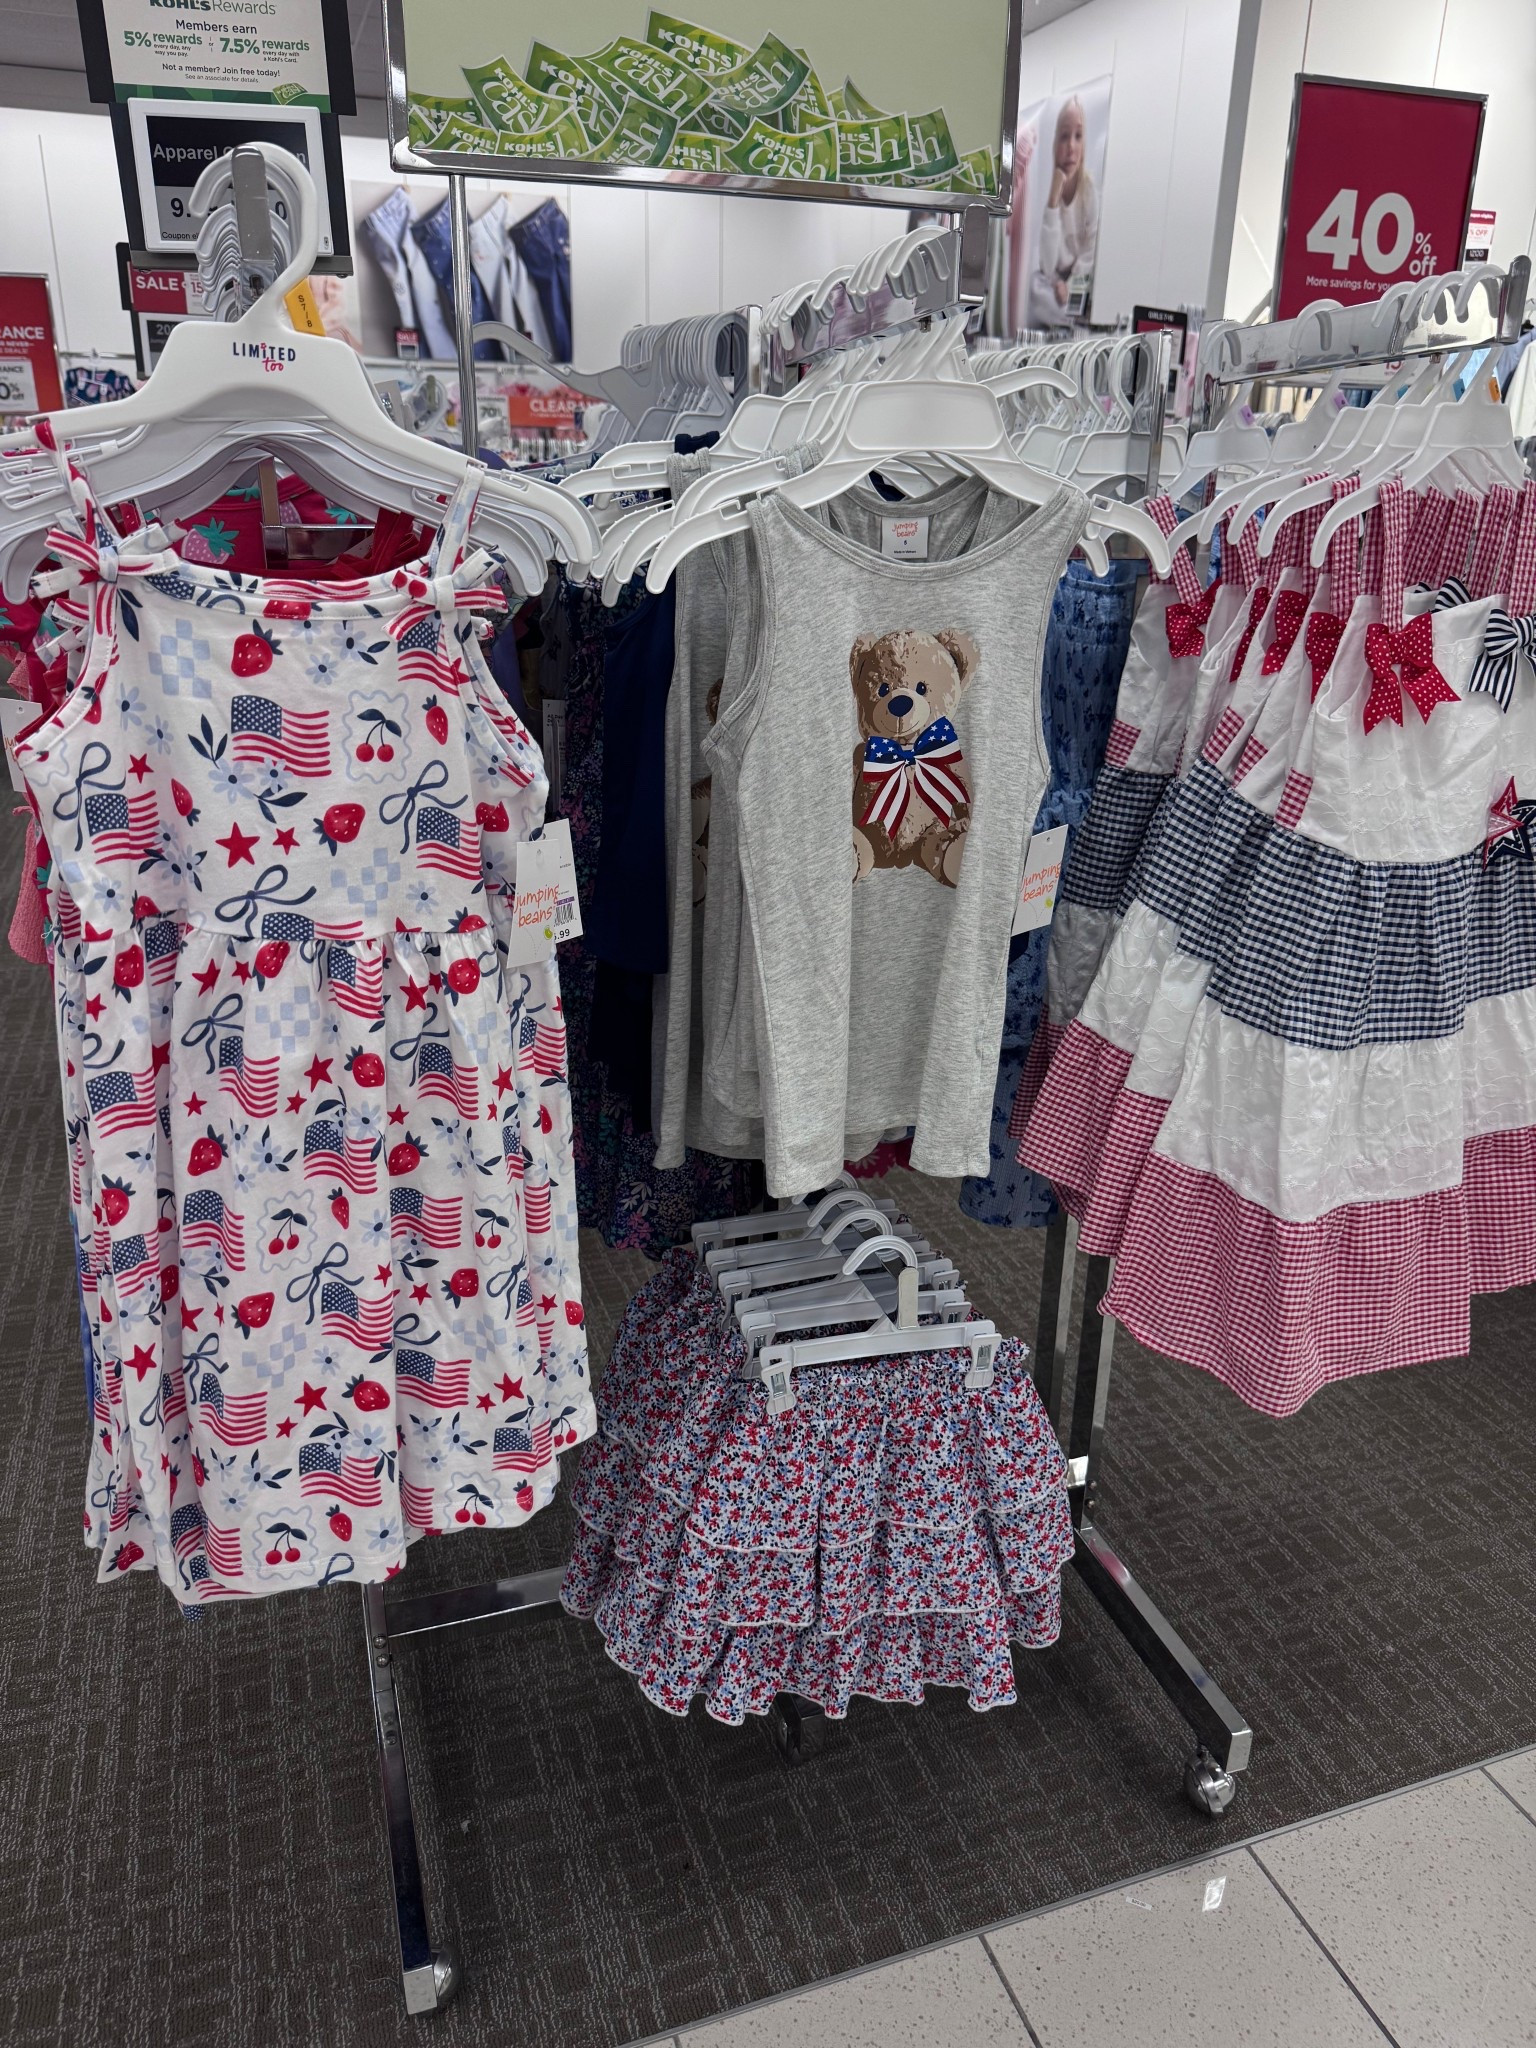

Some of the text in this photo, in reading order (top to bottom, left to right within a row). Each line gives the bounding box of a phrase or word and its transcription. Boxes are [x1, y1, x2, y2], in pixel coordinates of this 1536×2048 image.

[213, 0, 276, 15] Rewards
[175, 19, 257, 34] Members earn
[124, 30, 151, 47] 5%
[153, 33, 203, 45] rewards
[219, 38, 260, 54] 7.5%
[262, 40, 310, 51] rewards
[657, 28, 732, 68] KOHL'S
[162, 63, 176, 71] Not
[223, 67, 239, 75] Join
[256, 69, 280, 77] today!
[618, 46, 675, 77] KOHL'S
[494, 67, 538, 114] KOHL'S
[540, 60, 603, 102] KOHL
[715, 71, 760, 95] OHL'S
[504, 141, 556, 152] KOHL'S
[752, 132, 805, 159] KOHL'S
[839, 132, 871, 142] HL'S
[839, 126, 903, 165] ash
[152, 143, 218, 163] Apparel
[162, 231, 191, 241] Coupon
[1408, 255, 1438, 276] off
[135, 274, 180, 291] SALE
[1306, 276, 1328, 288] More
[1330, 277, 1361, 291] savings
[1363, 278, 1376, 290] for
[262, 357, 284, 372] too
[1020, 863, 1061, 893] jumping
[514, 884, 560, 914] jumping
[1023, 880, 1057, 903] beans
[518, 904, 553, 929] beans
